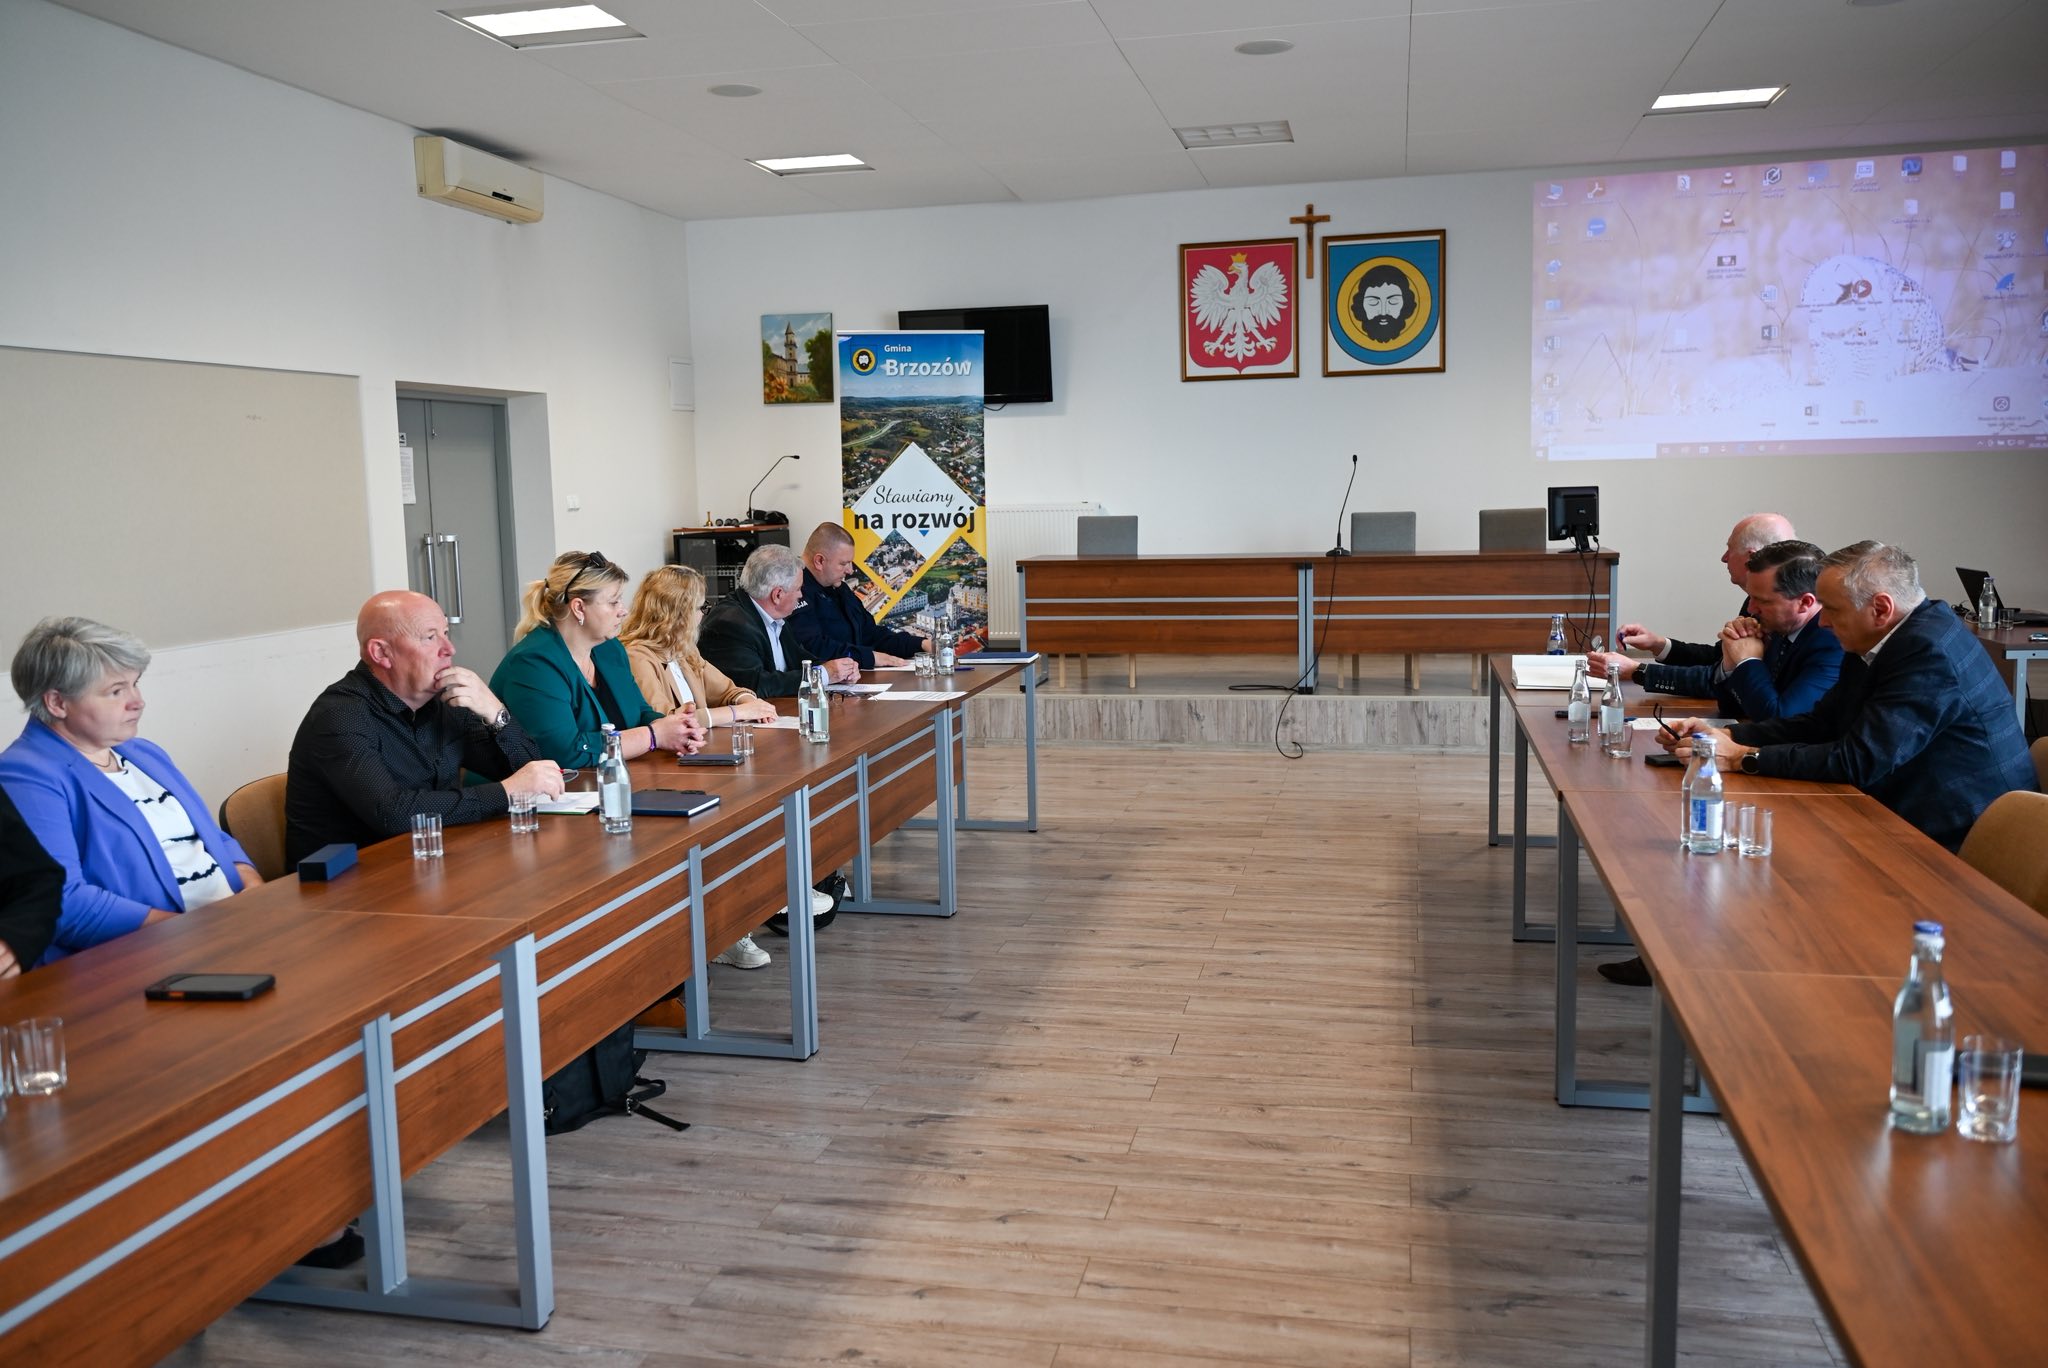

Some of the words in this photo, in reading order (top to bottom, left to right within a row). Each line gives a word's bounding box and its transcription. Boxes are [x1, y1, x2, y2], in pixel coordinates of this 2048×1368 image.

[884, 344, 912, 353] Gmina
[885, 356, 972, 377] Brzozów
[873, 484, 956, 508] Stawiamy
[854, 513, 884, 530] na
[891, 506, 976, 534] rozwój
